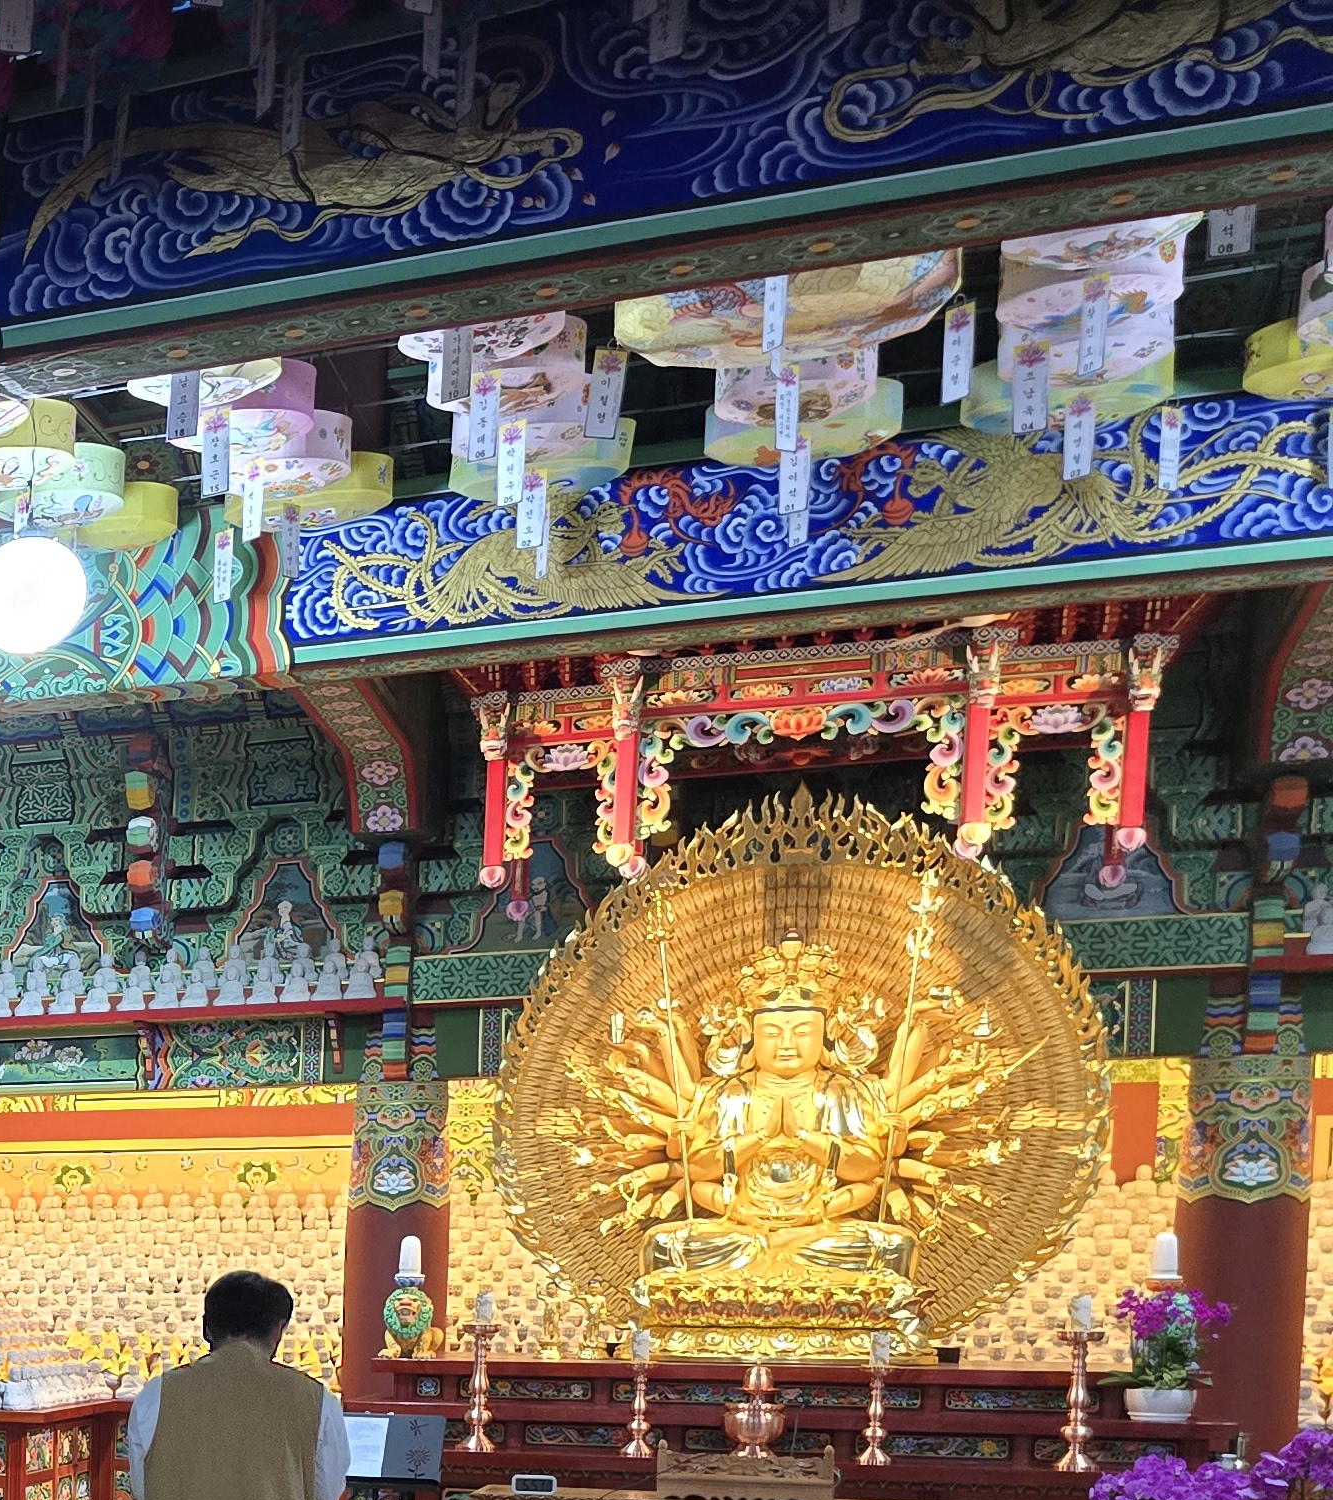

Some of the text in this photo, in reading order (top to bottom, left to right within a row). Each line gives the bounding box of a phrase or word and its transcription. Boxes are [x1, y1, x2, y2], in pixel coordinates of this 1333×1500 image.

[1217, 243, 1233, 254] 08
[1083, 362, 1093, 372] 07
[448, 390, 459, 398] 10
[1021, 422, 1033, 431] 04
[174, 429, 185, 437] 18
[475, 450, 485, 458] 06
[503, 495, 513, 503] 05
[521, 539, 532, 547] 02
